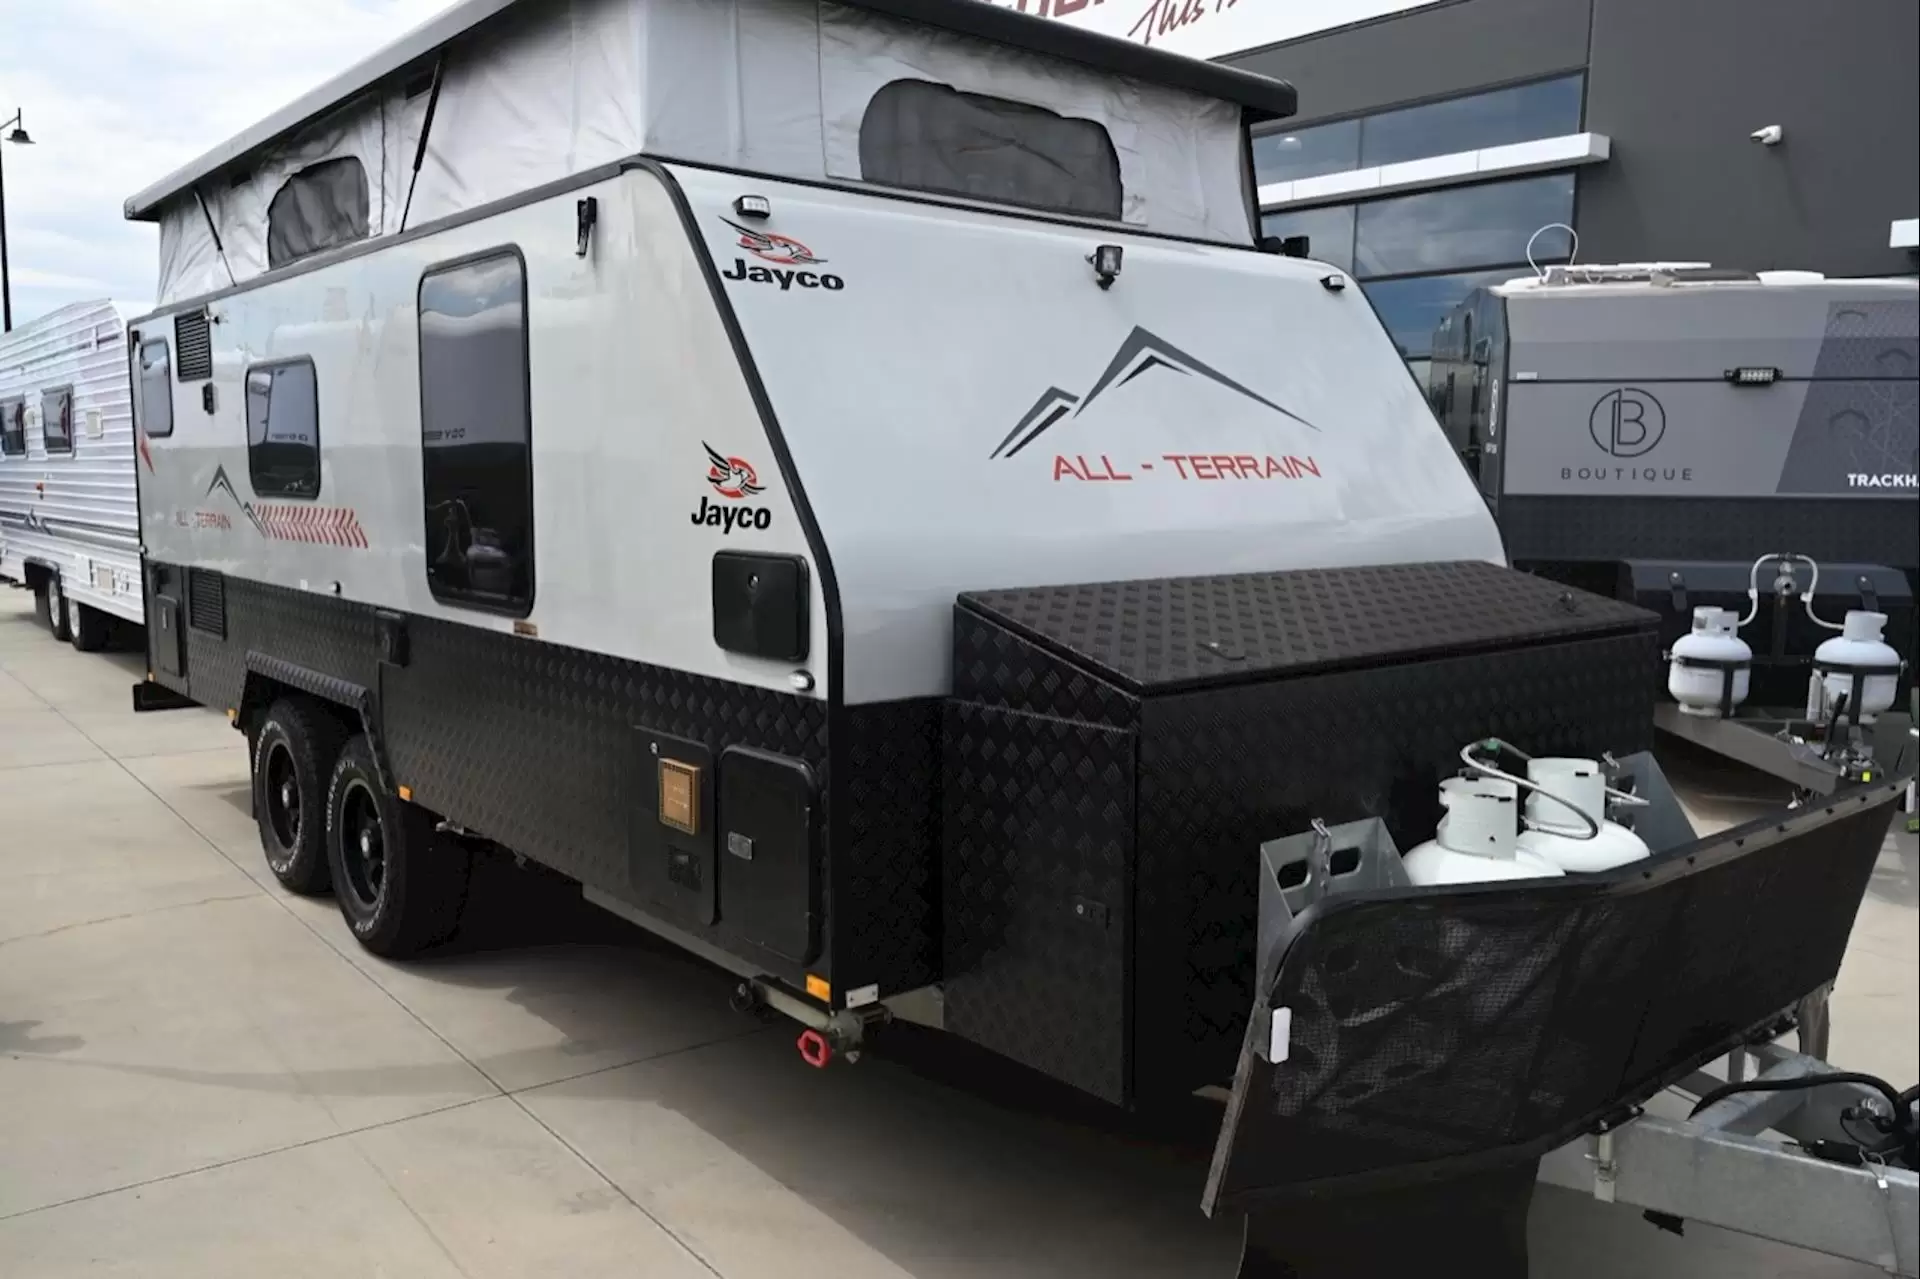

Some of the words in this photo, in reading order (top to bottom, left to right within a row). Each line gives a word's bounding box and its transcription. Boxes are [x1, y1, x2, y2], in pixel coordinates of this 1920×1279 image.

[722, 257, 844, 291] Jayco
[1054, 455, 1133, 480] ALL
[1162, 455, 1322, 480] TERRAIN
[1561, 467, 1693, 482] BOUTIQUE
[1847, 473, 1919, 488] TRACKH
[691, 496, 771, 535] Jayco
